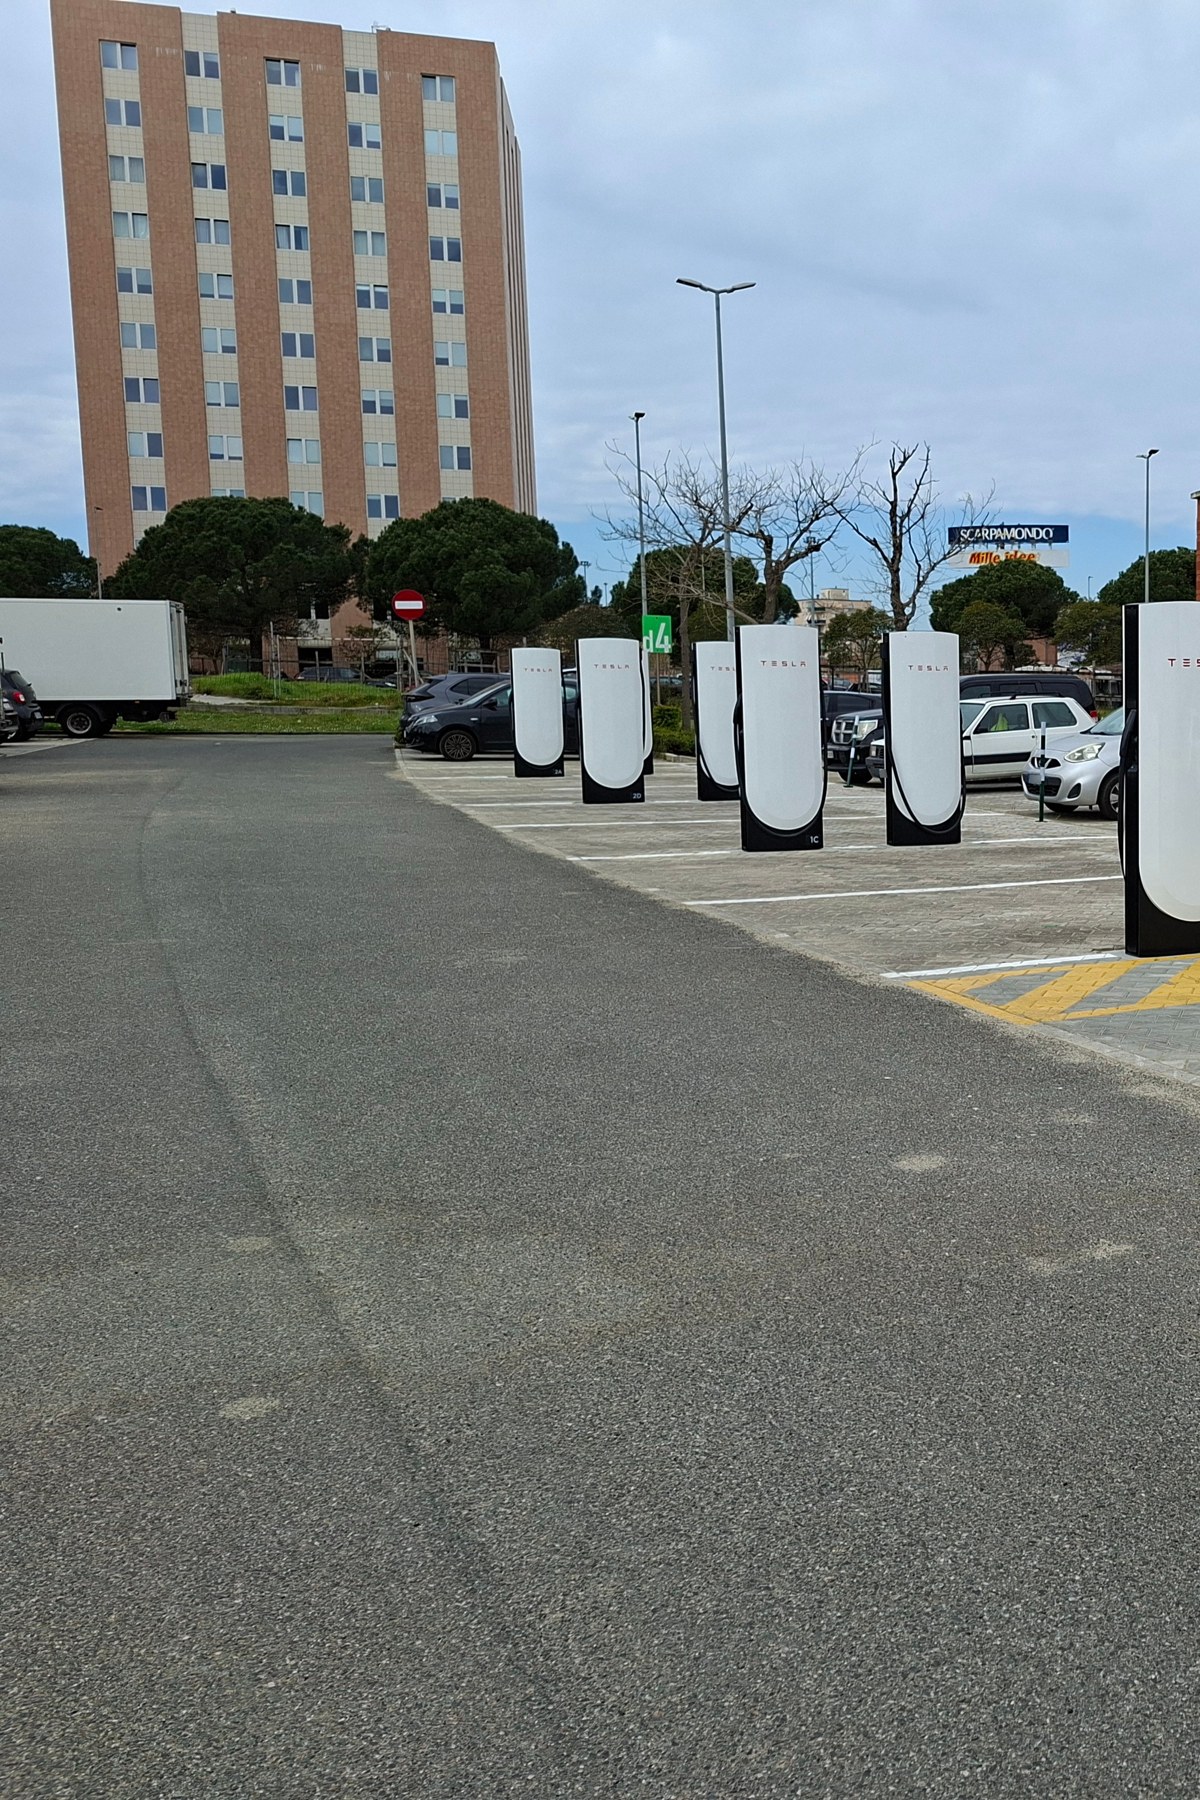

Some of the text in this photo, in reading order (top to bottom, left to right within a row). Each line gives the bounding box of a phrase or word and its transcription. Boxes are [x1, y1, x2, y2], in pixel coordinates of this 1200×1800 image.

[960, 527, 1053, 541] SCARPAMONDO
[969, 552, 1000, 565] Mille
[642, 622, 672, 653] d4
[809, 835, 819, 844] 1C
